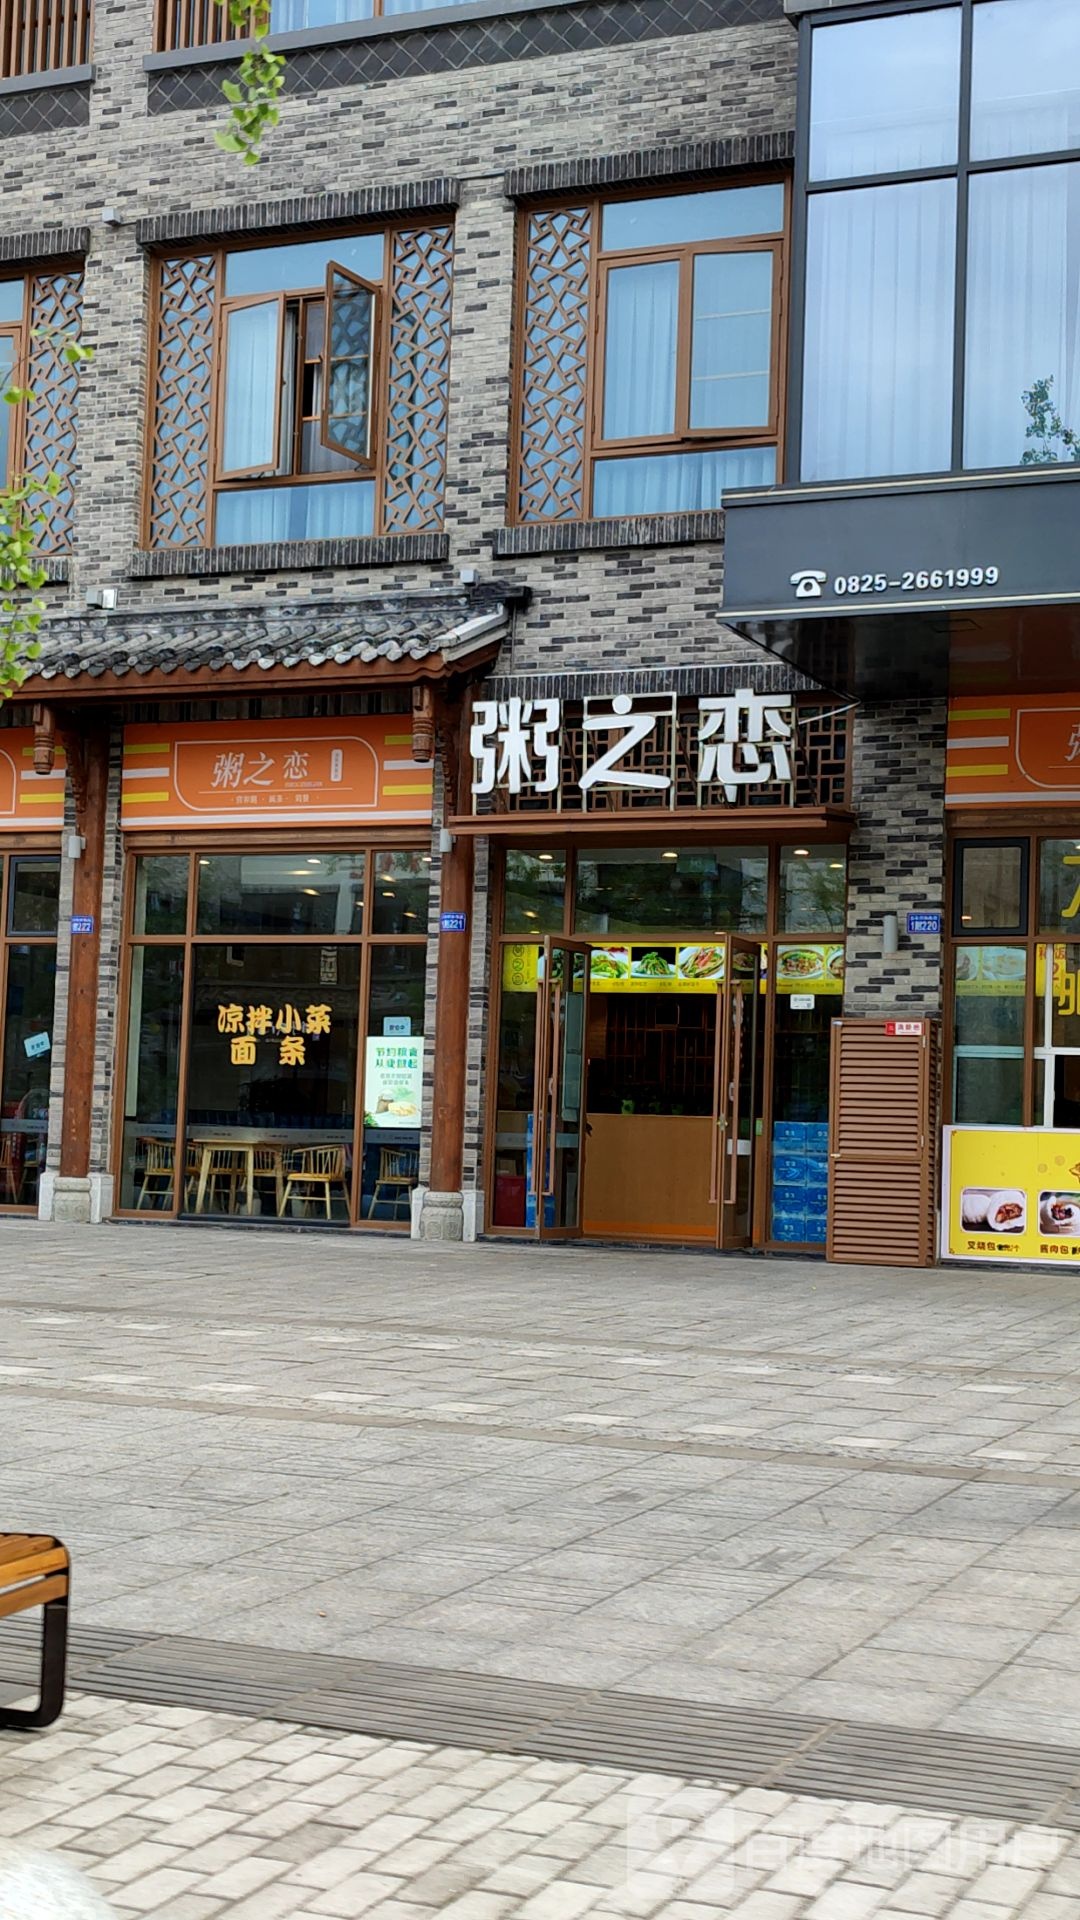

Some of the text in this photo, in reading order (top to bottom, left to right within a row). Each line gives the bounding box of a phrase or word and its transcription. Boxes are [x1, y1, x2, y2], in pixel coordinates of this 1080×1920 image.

[834, 566, 999, 595] 0825-2661999
[470, 688, 792, 803] 粥之恋
[210, 751, 311, 788] 粥之恋
